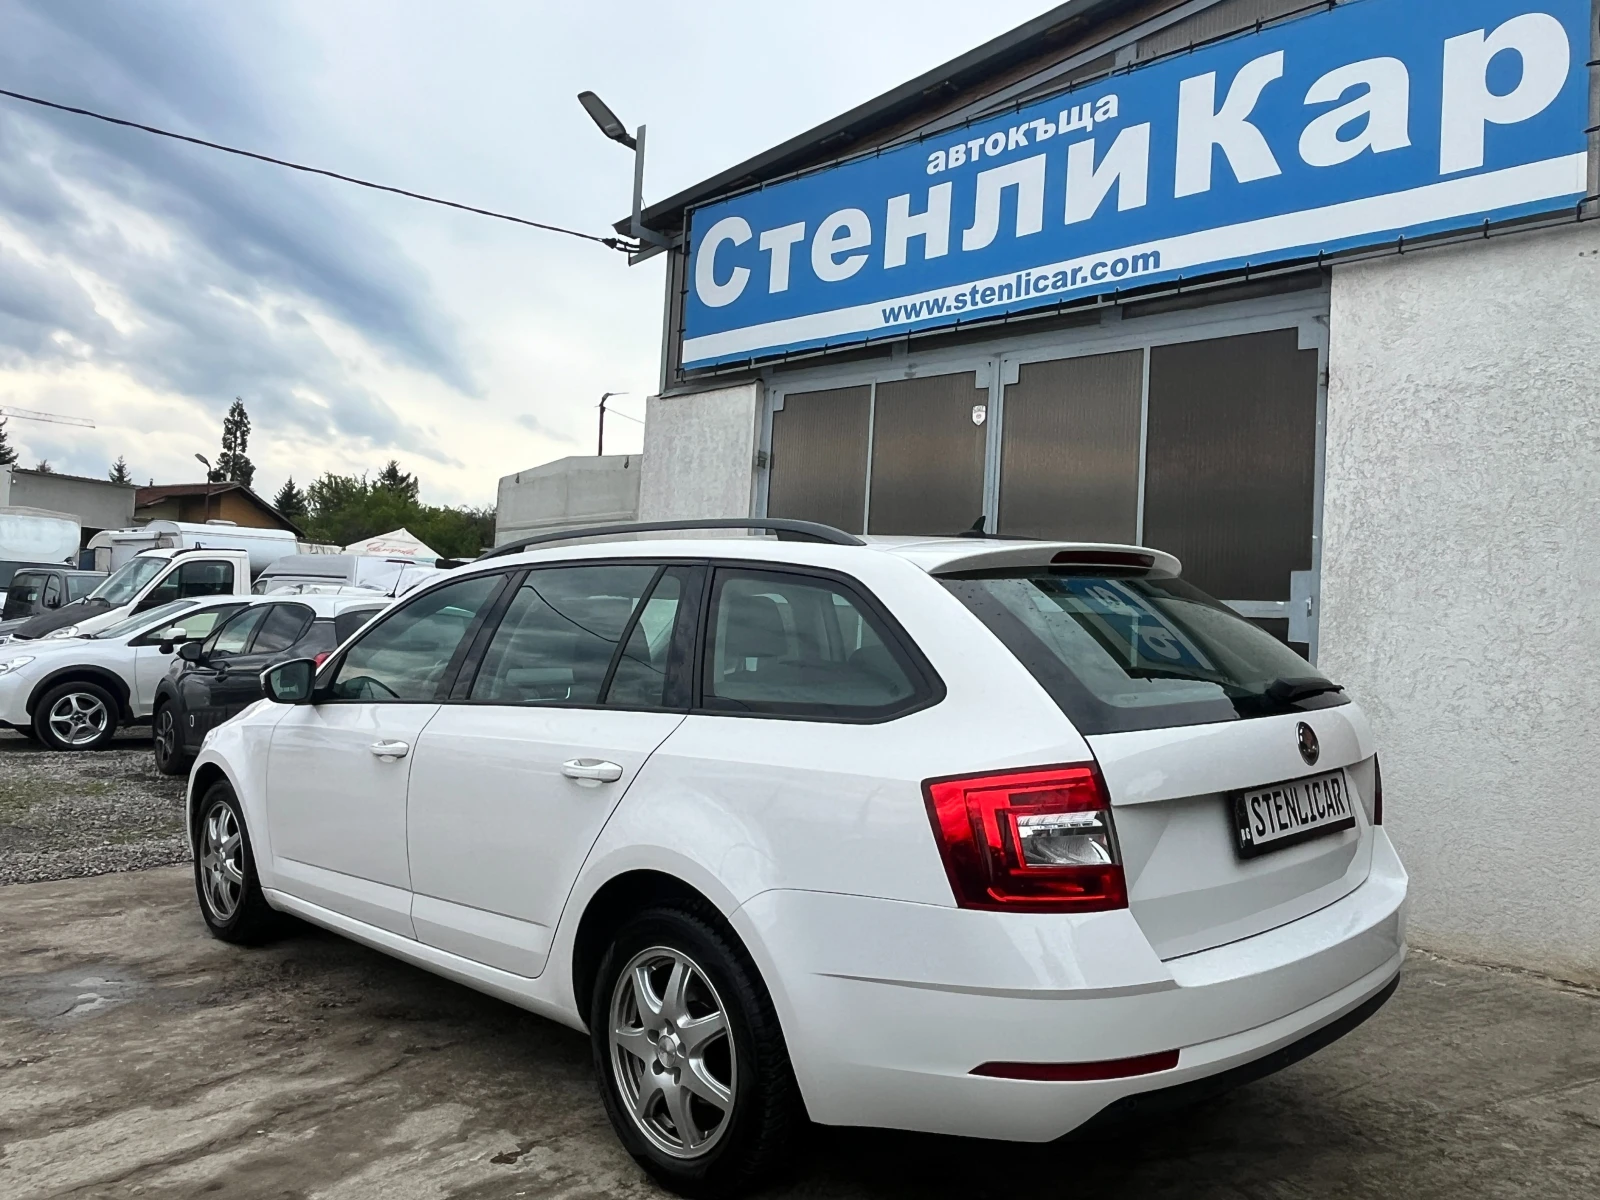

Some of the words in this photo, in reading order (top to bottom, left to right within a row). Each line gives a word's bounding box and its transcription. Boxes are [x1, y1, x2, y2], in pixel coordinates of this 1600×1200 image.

[695, 12, 1570, 308] СтенлиКар
[926, 94, 1119, 175] автокъща
[882, 250, 1161, 324] www.stenlicar.com
[1250, 778, 1346, 838] STENLICAR
